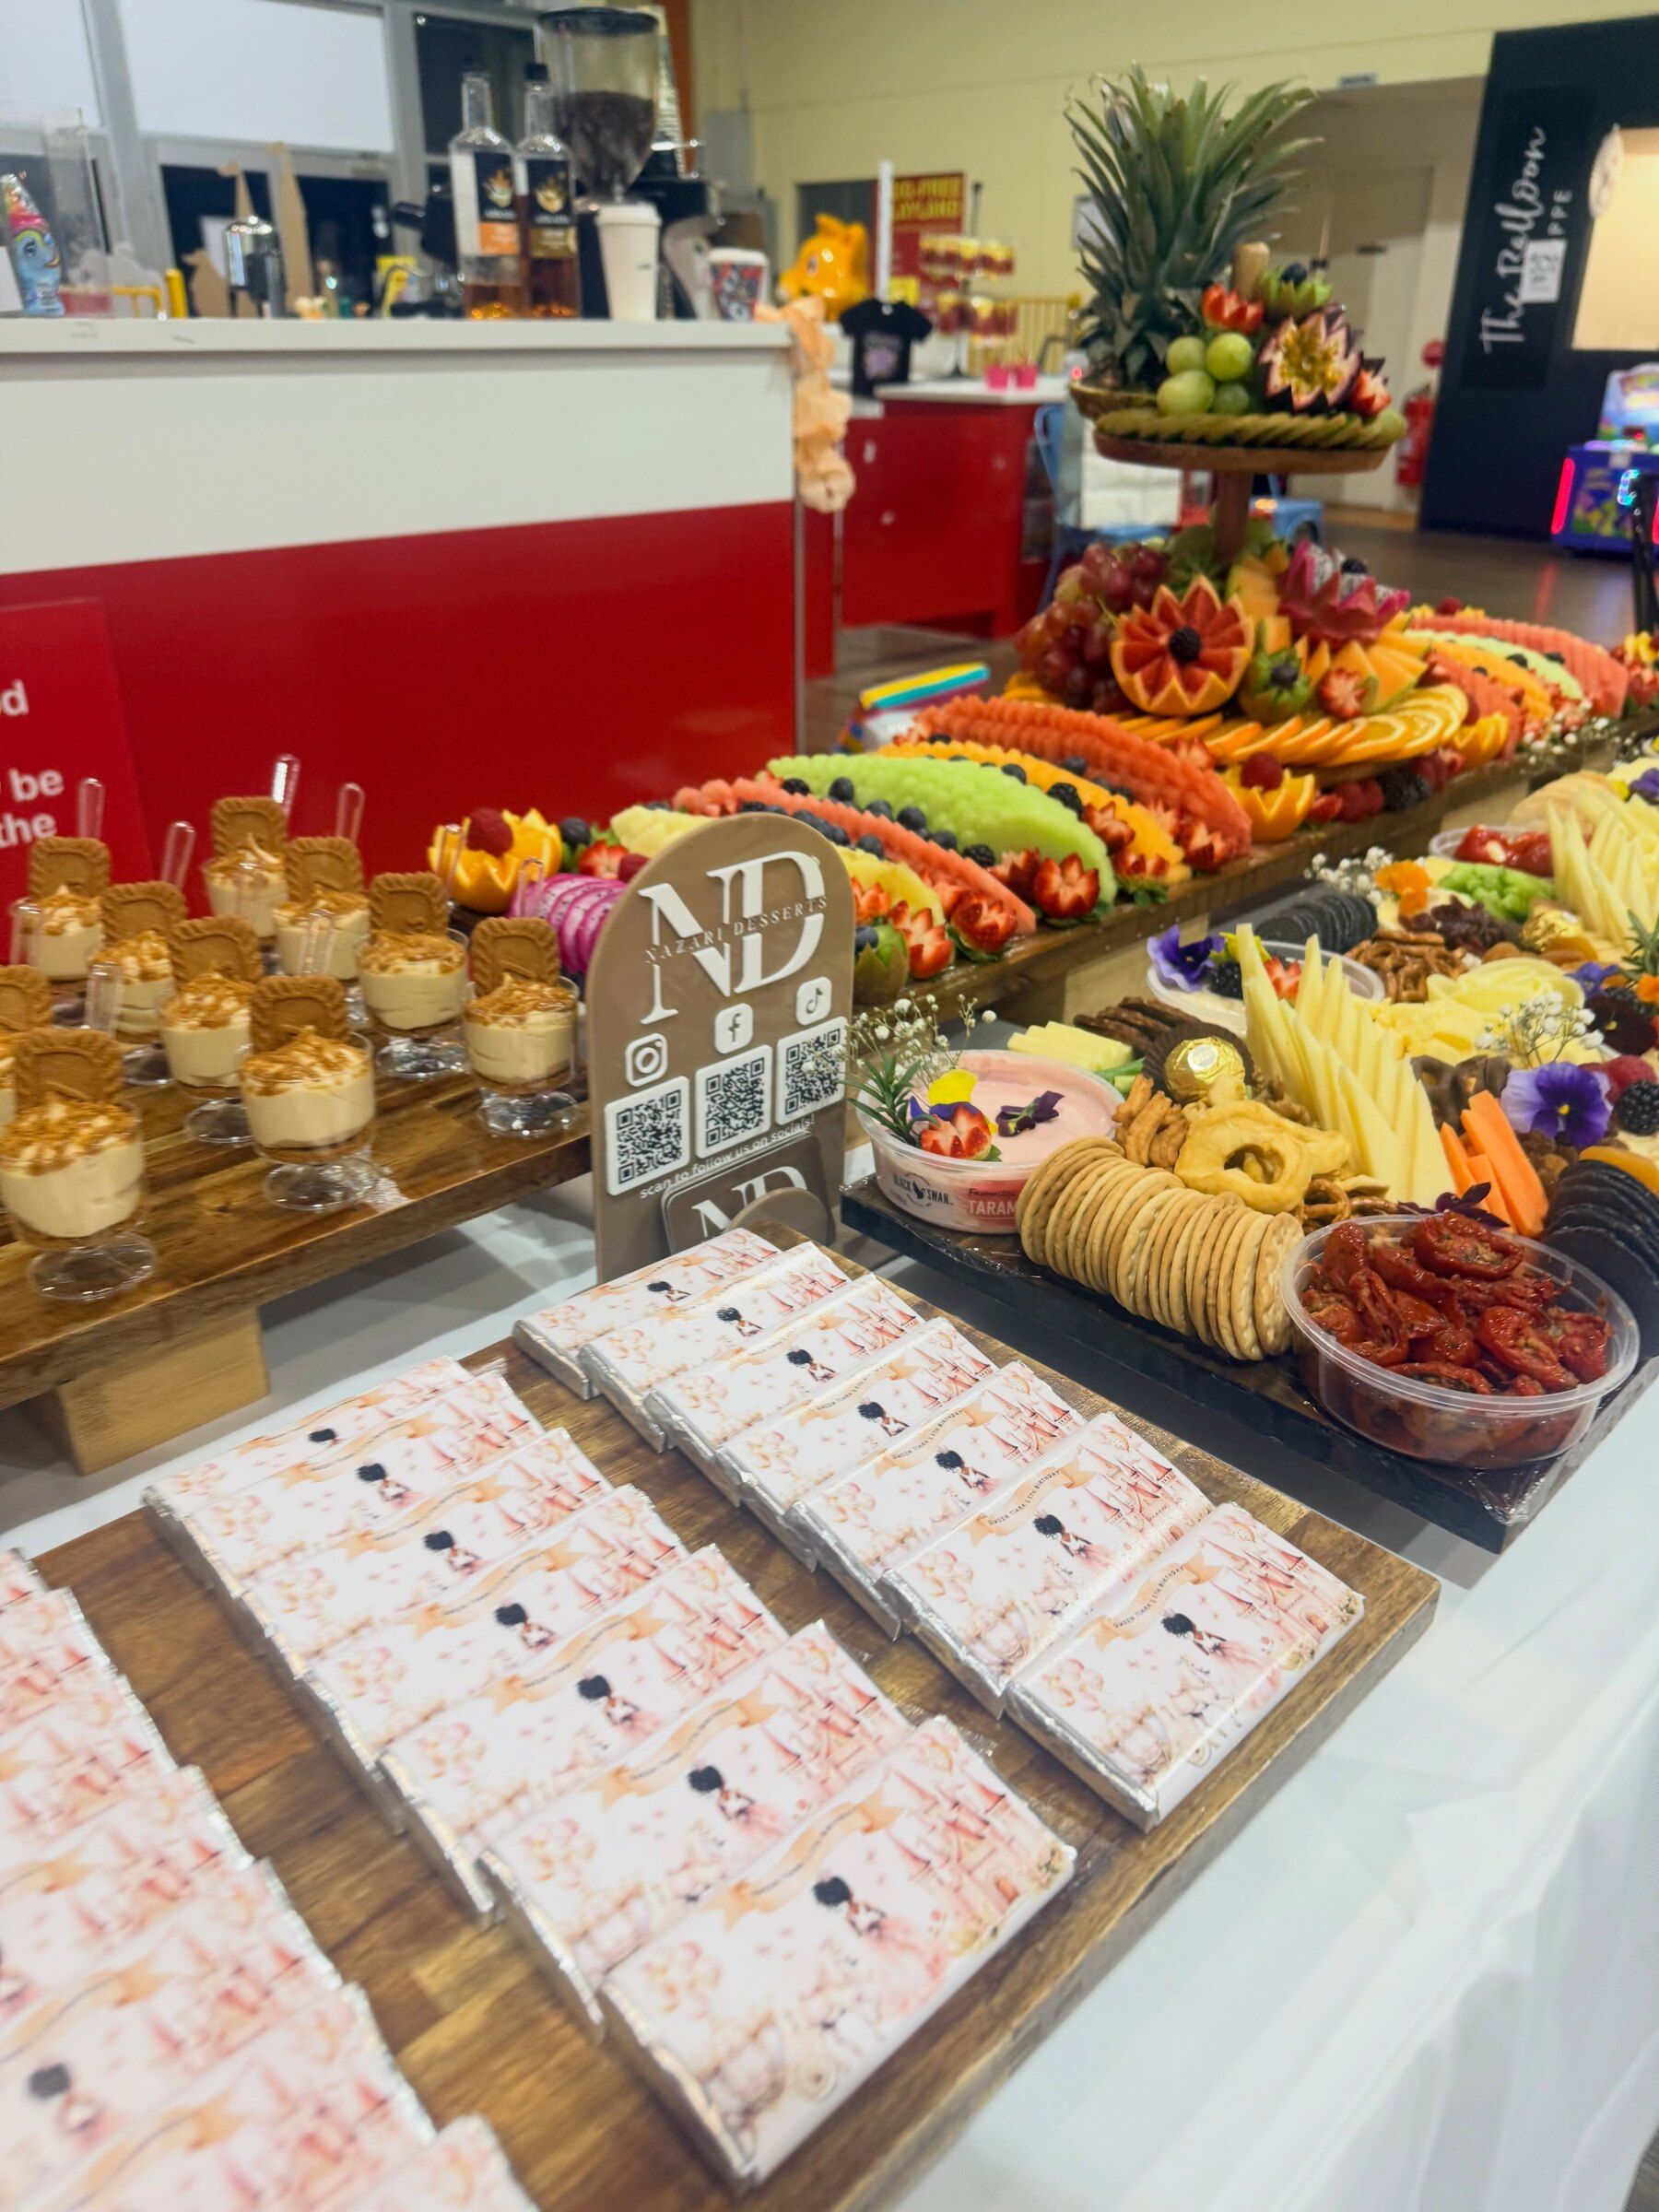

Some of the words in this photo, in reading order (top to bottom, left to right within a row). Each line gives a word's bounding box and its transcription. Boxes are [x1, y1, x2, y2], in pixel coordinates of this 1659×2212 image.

[1547, 189, 1573, 236] PPE
[7, 768, 65, 803] be
[637, 851, 825, 1024] ND
[734, 896, 828, 936] DESSERTS
[640, 1178, 671, 1198] scan
[675, 1169, 689, 1183] to
[692, 1152, 733, 1174] follow
[735, 1146, 751, 1156] us
[752, 1136, 769, 1148] on
[771, 1113, 815, 1139] socials!
[926, 1189, 949, 1205] SWAN
